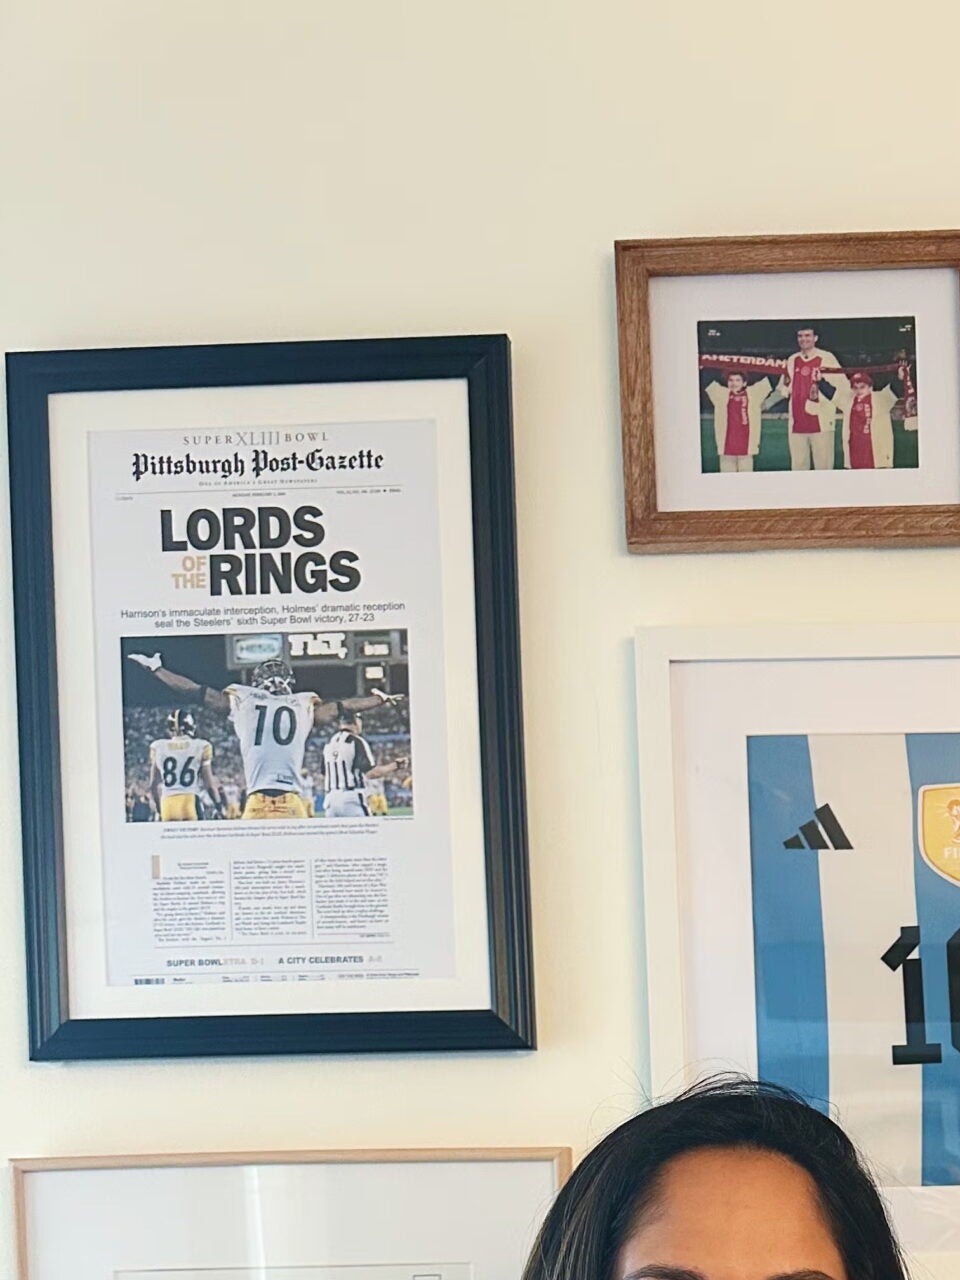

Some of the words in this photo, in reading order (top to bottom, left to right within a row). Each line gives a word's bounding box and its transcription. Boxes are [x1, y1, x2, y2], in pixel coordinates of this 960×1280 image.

[183, 434, 233, 446] SUPER
[285, 431, 329, 442] BOWL
[132, 451, 245, 482] Pittsburgh
[252, 447, 384, 478] Post-Gazette
[160, 505, 326, 552] LORDS
[182, 556, 207, 572] OF
[171, 572, 207, 590] THE
[209, 550, 362, 597] RINGS
[120, 608, 167, 619] Harrison's
[168, 606, 221, 617] immaculate
[223, 604, 280, 616] interception,
[282, 604, 319, 614] Holmes'
[321, 603, 361, 613] dramatic
[362, 602, 405, 612] reception
[154, 618, 173, 628] seal
[176, 617, 190, 627] the
[193, 616, 234, 627] Steelers'
[237, 615, 259, 626] sixth
[260, 615, 286, 626] Super
[290, 614, 312, 624] Bowl
[314, 613, 346, 625] victory,
[348, 612, 375, 622] 27-23
[253, 704, 298, 746] 10
[163, 755, 195, 787] 86
[166, 959, 196, 967] SUPER
[198, 959, 222, 967] BOWL
[308, 955, 364, 964] CELEBRATES
